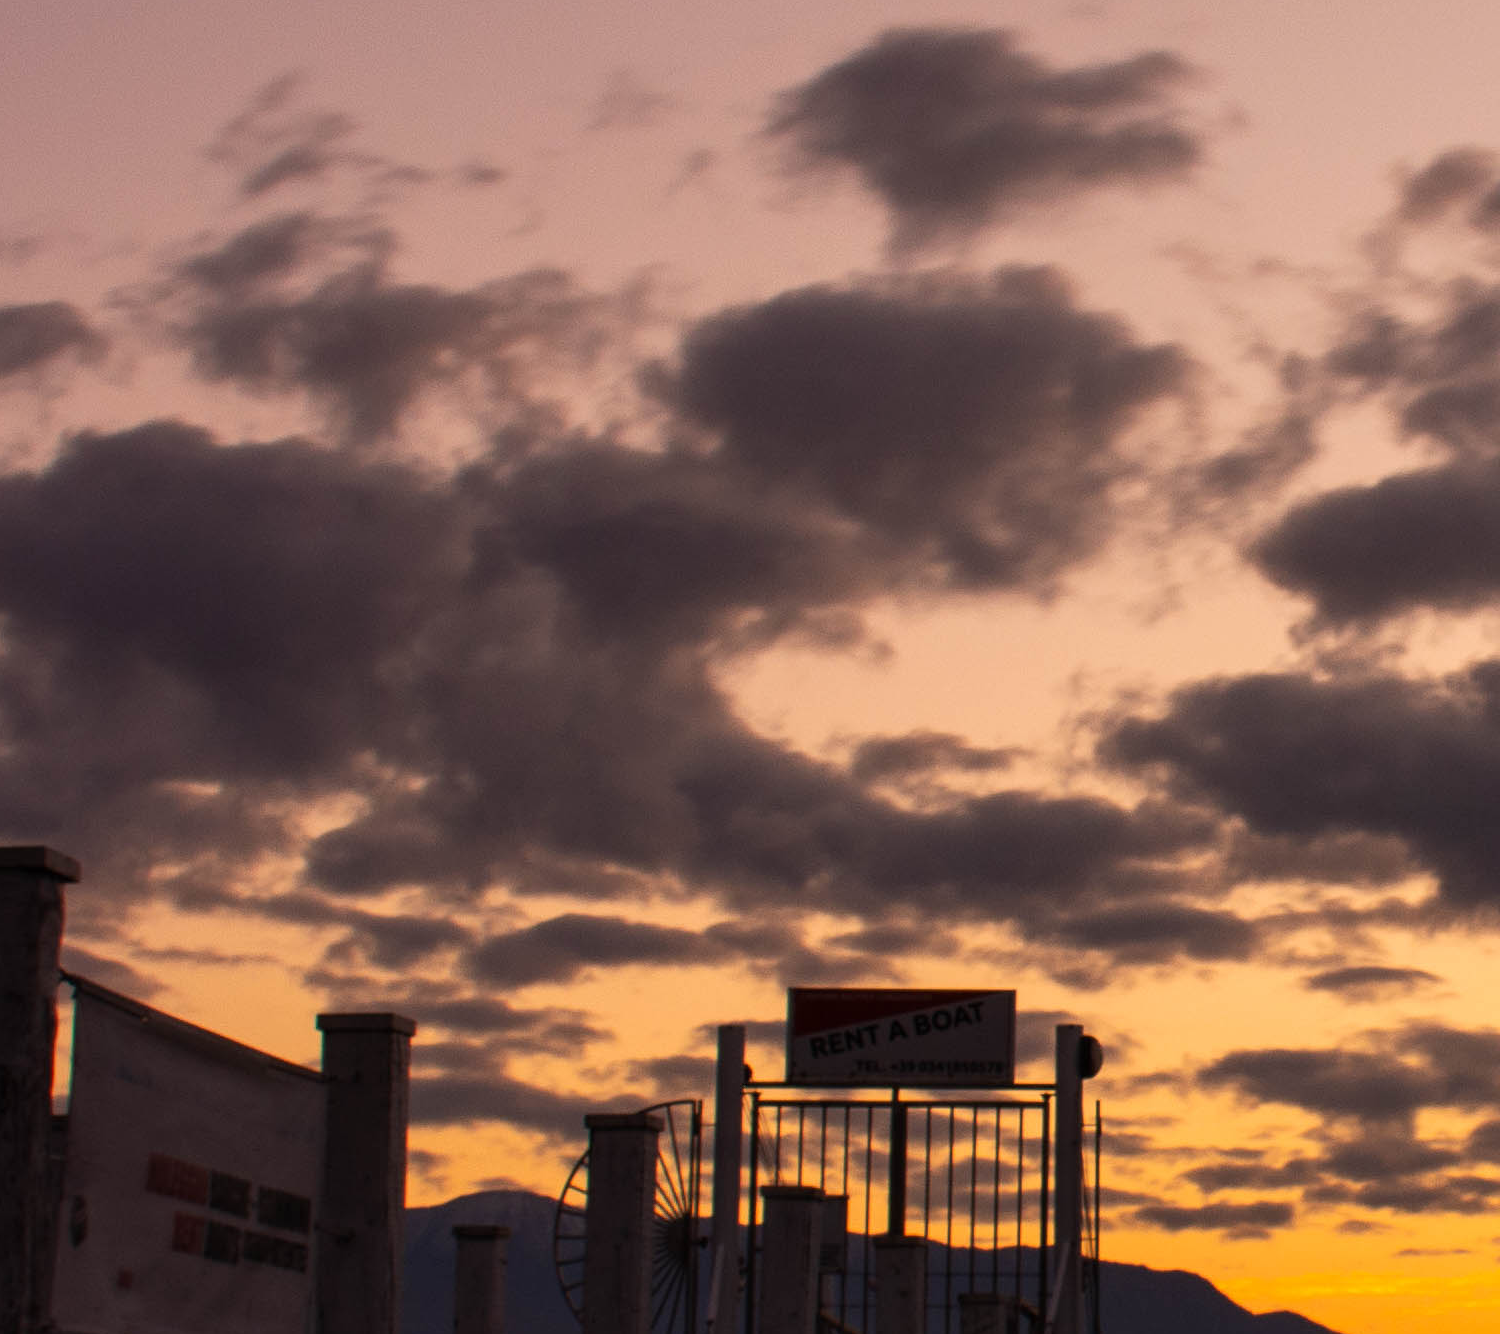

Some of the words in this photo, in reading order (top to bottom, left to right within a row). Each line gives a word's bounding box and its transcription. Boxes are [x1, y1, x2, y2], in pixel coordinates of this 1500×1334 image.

[810, 1024, 878, 1058] RENT
[889, 1021, 907, 1042] A
[914, 1002, 984, 1035] BOAT
